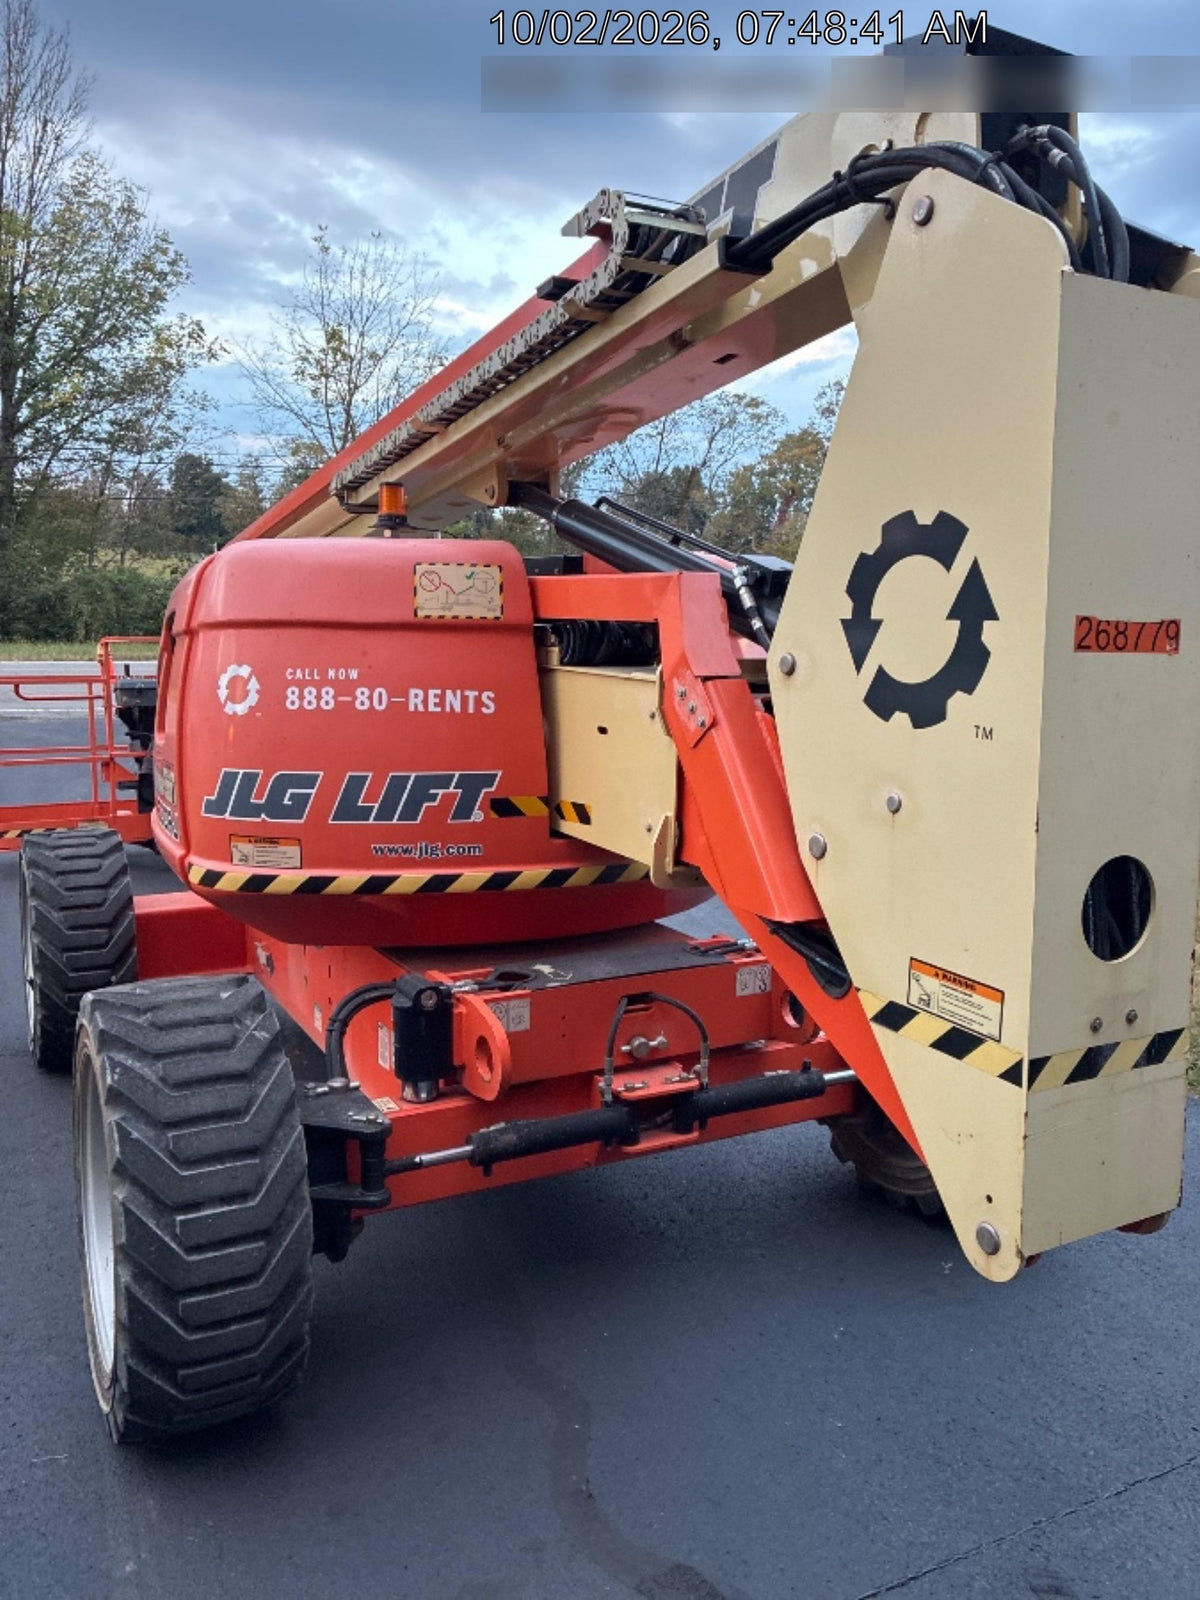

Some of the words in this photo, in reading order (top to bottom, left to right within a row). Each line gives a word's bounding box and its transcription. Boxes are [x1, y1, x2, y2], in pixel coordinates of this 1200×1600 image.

[1076, 616, 1180, 653] 268779
[285, 668, 320, 680] CALL
[328, 668, 360, 680] NOW
[285, 686, 496, 714] 888-80-RENTS
[201, 768, 324, 823] JLG
[371, 841, 484, 860] www.jlg.com
